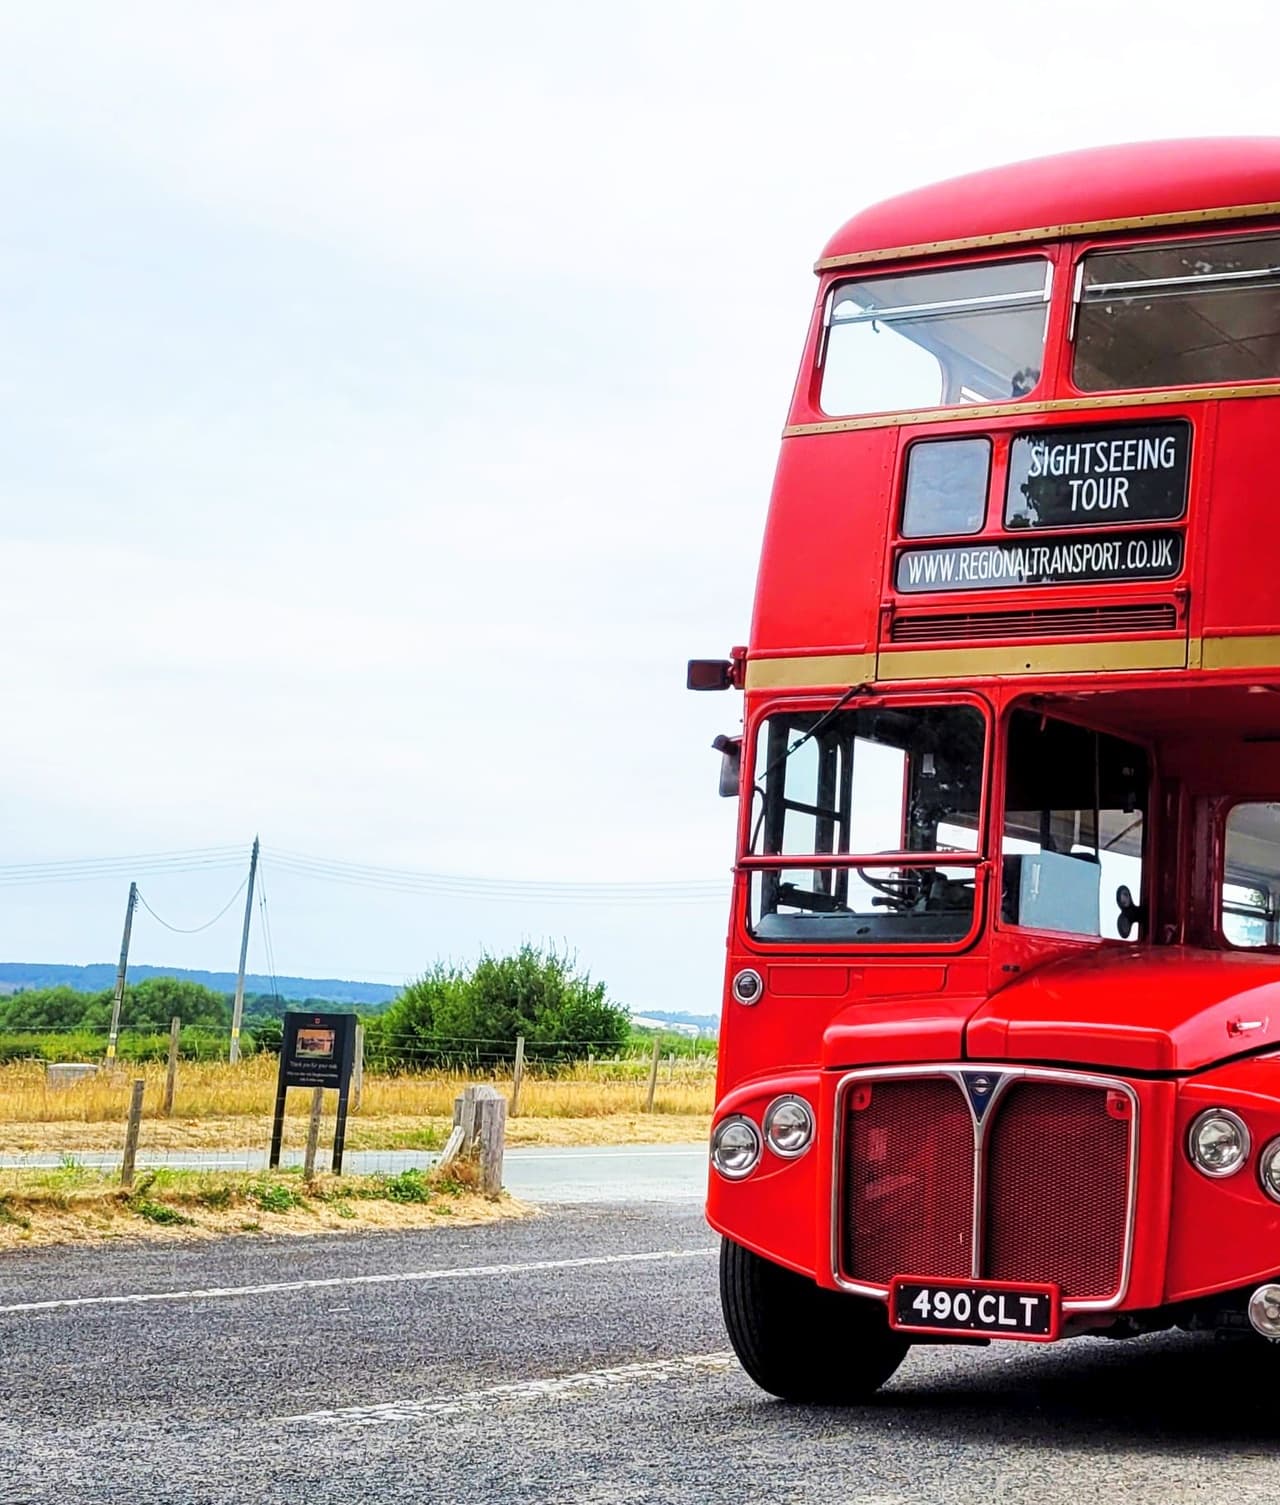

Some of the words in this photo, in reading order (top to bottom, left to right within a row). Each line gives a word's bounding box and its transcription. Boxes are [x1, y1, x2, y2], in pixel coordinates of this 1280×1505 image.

[1027, 436, 1176, 478] SIGHTSEEING
[1068, 476, 1130, 512] TOUR
[907, 538, 1174, 585] WWW.REGIONALTRANSPORT.CO.UK
[912, 1289, 972, 1321] 490
[978, 1295, 1039, 1327] CLT
